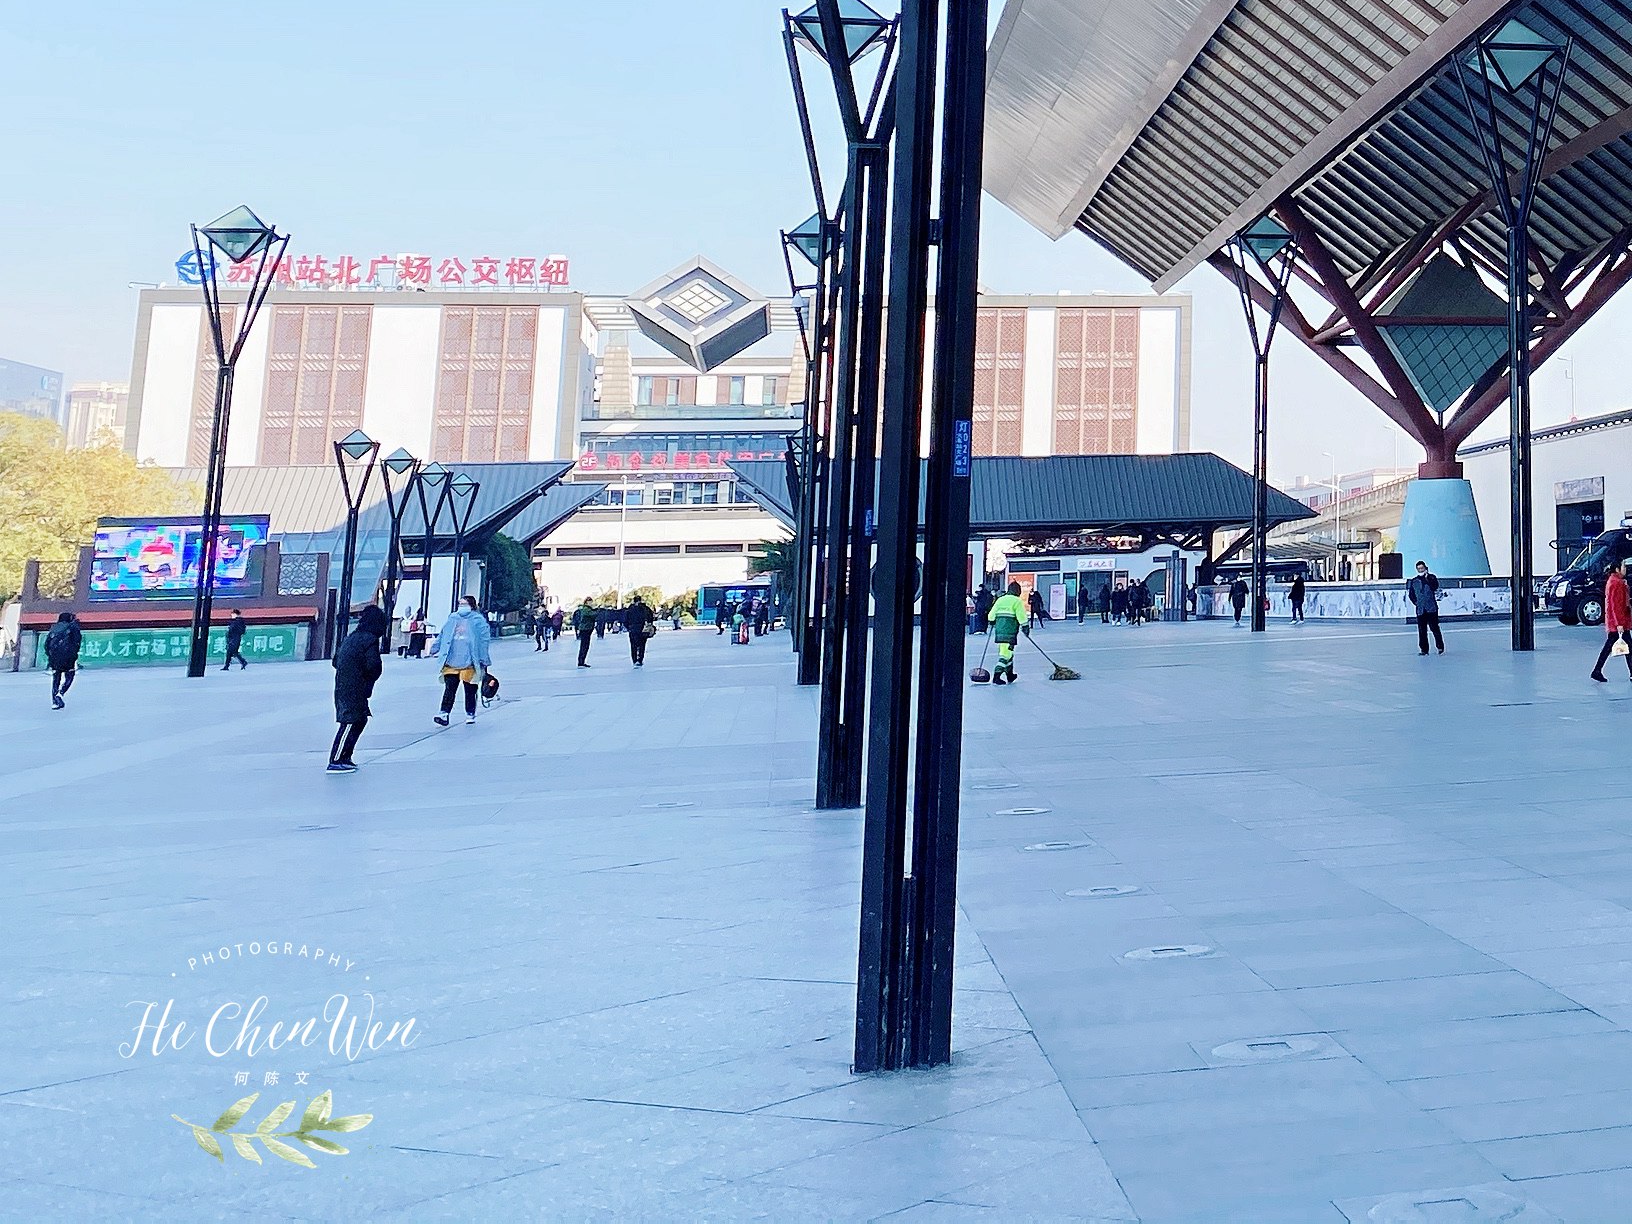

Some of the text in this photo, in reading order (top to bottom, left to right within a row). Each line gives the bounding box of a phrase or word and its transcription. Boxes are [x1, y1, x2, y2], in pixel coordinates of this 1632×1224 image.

[225, 254, 570, 285] 苏州站北广场公交枢纽
